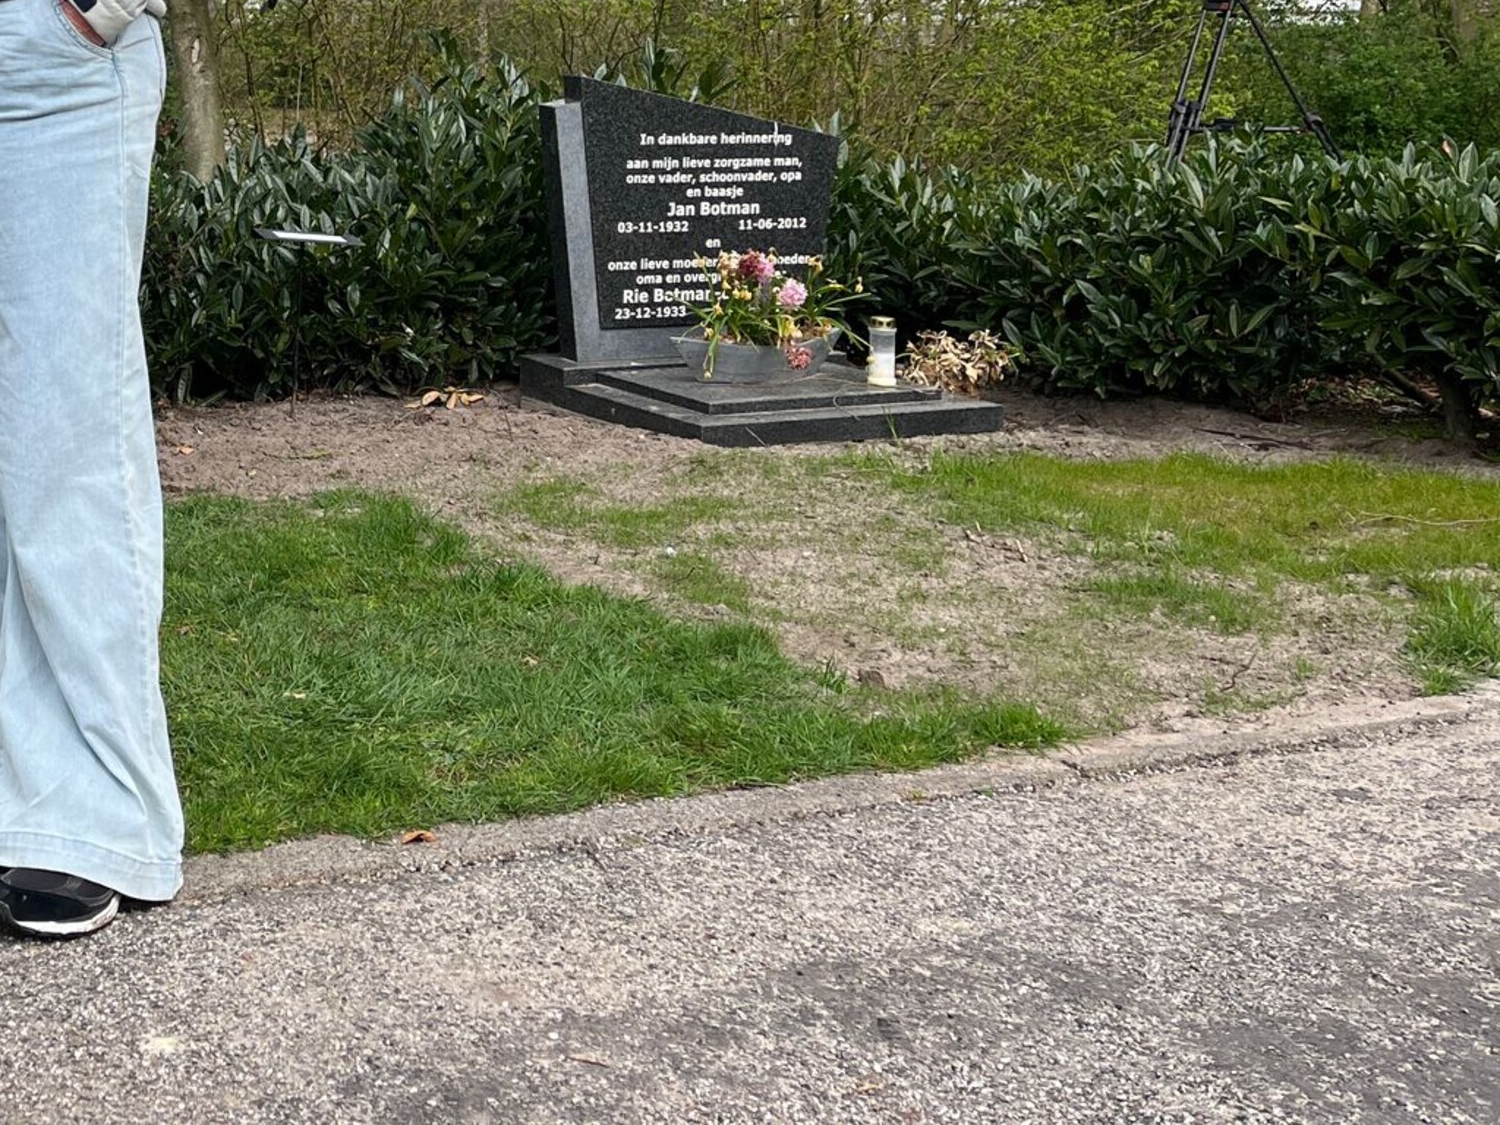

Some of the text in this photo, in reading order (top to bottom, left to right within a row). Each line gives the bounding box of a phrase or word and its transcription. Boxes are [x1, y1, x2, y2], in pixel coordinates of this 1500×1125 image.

[639, 131, 793, 146] In dankbare herinnering
[626, 157, 803, 171] aan mijn lieve zorgzame man,
[626, 171, 802, 186] onze vader, schoonvader, opa
[686, 185, 744, 200] en baasje
[667, 201, 761, 218] Jan Botman
[617, 217, 807, 234] 03-11-1932 11-06-2012
[705, 238, 722, 249] en
[608, 260, 638, 271] onze
[640, 257, 670, 270] lieve
[672, 256, 718, 269] moeer
[636, 274, 662, 285] oma
[665, 273, 681, 284] en
[622, 288, 650, 304] Rie
[615, 305, 687, 320] 23-12-1933
